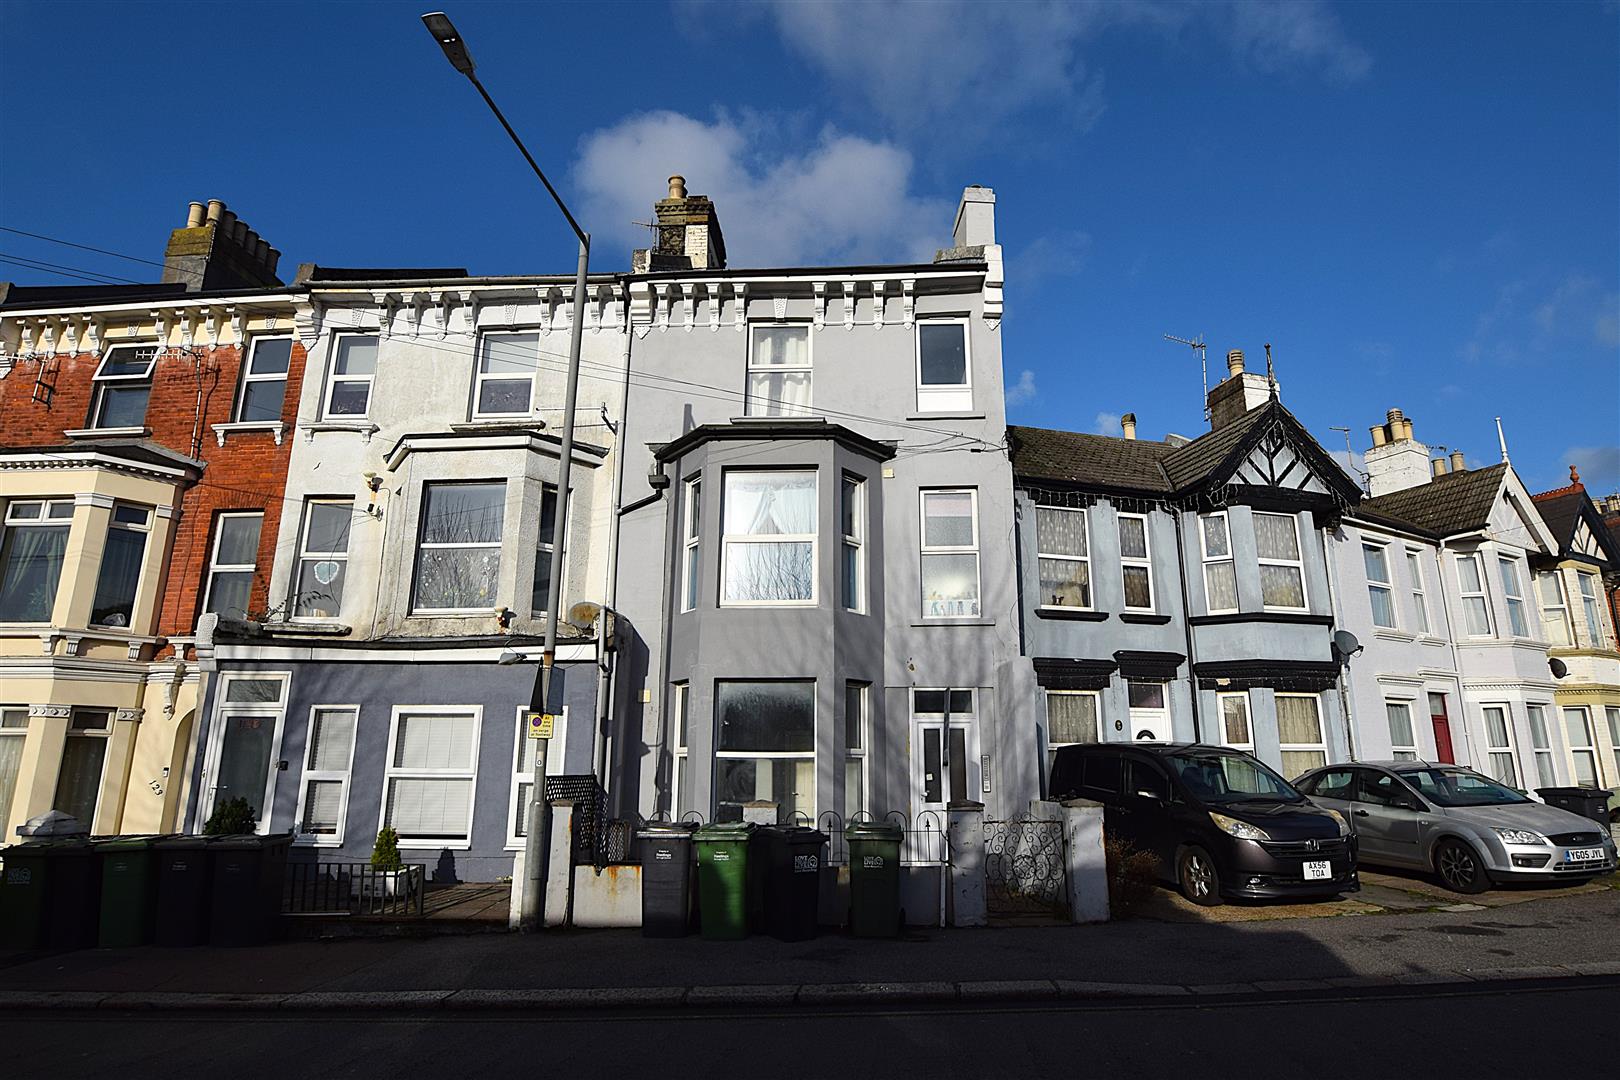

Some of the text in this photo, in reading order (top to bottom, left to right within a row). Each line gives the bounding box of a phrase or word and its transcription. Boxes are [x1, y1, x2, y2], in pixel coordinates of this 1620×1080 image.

[149, 780, 163, 796] 123
[1571, 850, 1603, 860] YG05 JYL
[1309, 861, 1326, 869] AX56
